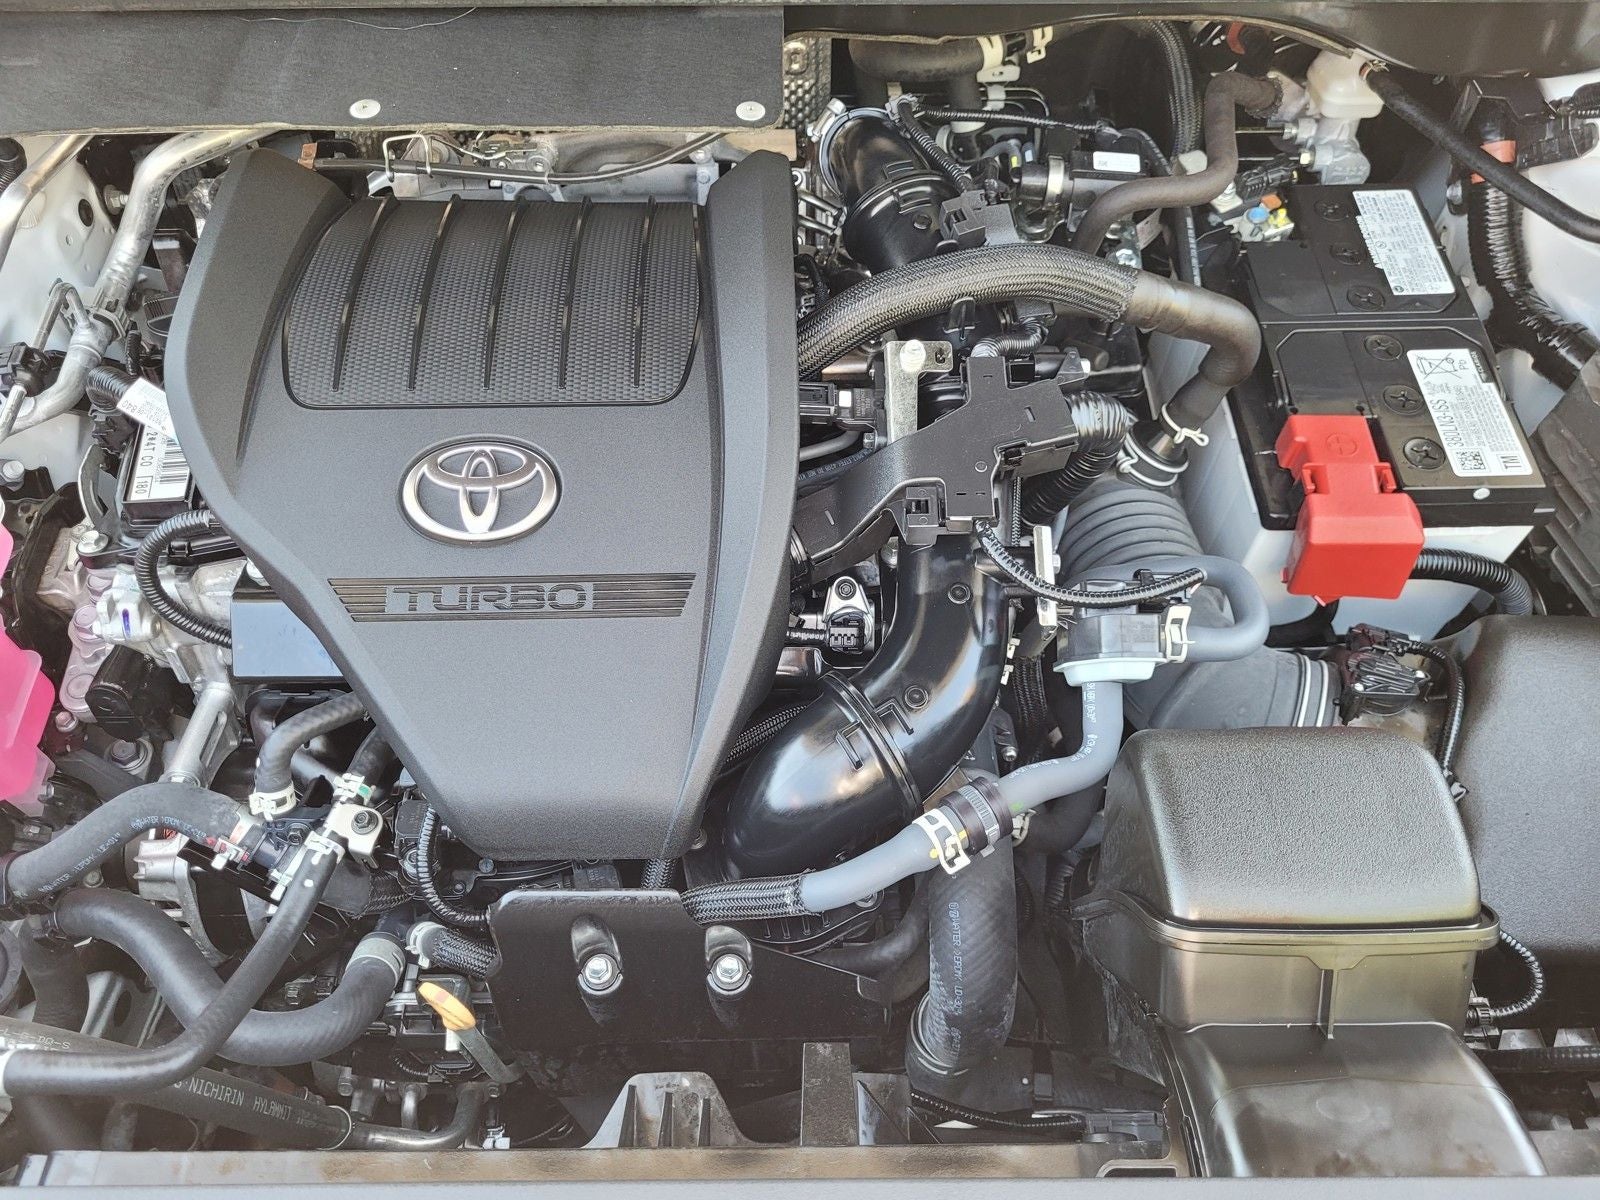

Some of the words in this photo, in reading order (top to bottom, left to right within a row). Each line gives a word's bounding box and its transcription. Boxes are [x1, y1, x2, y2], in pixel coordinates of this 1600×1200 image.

[1500, 455, 1522, 469] TM
[135, 480, 149, 495] 180
[392, 583, 587, 611] TURBO
[188, 1077, 245, 1107] NICHIRIN
